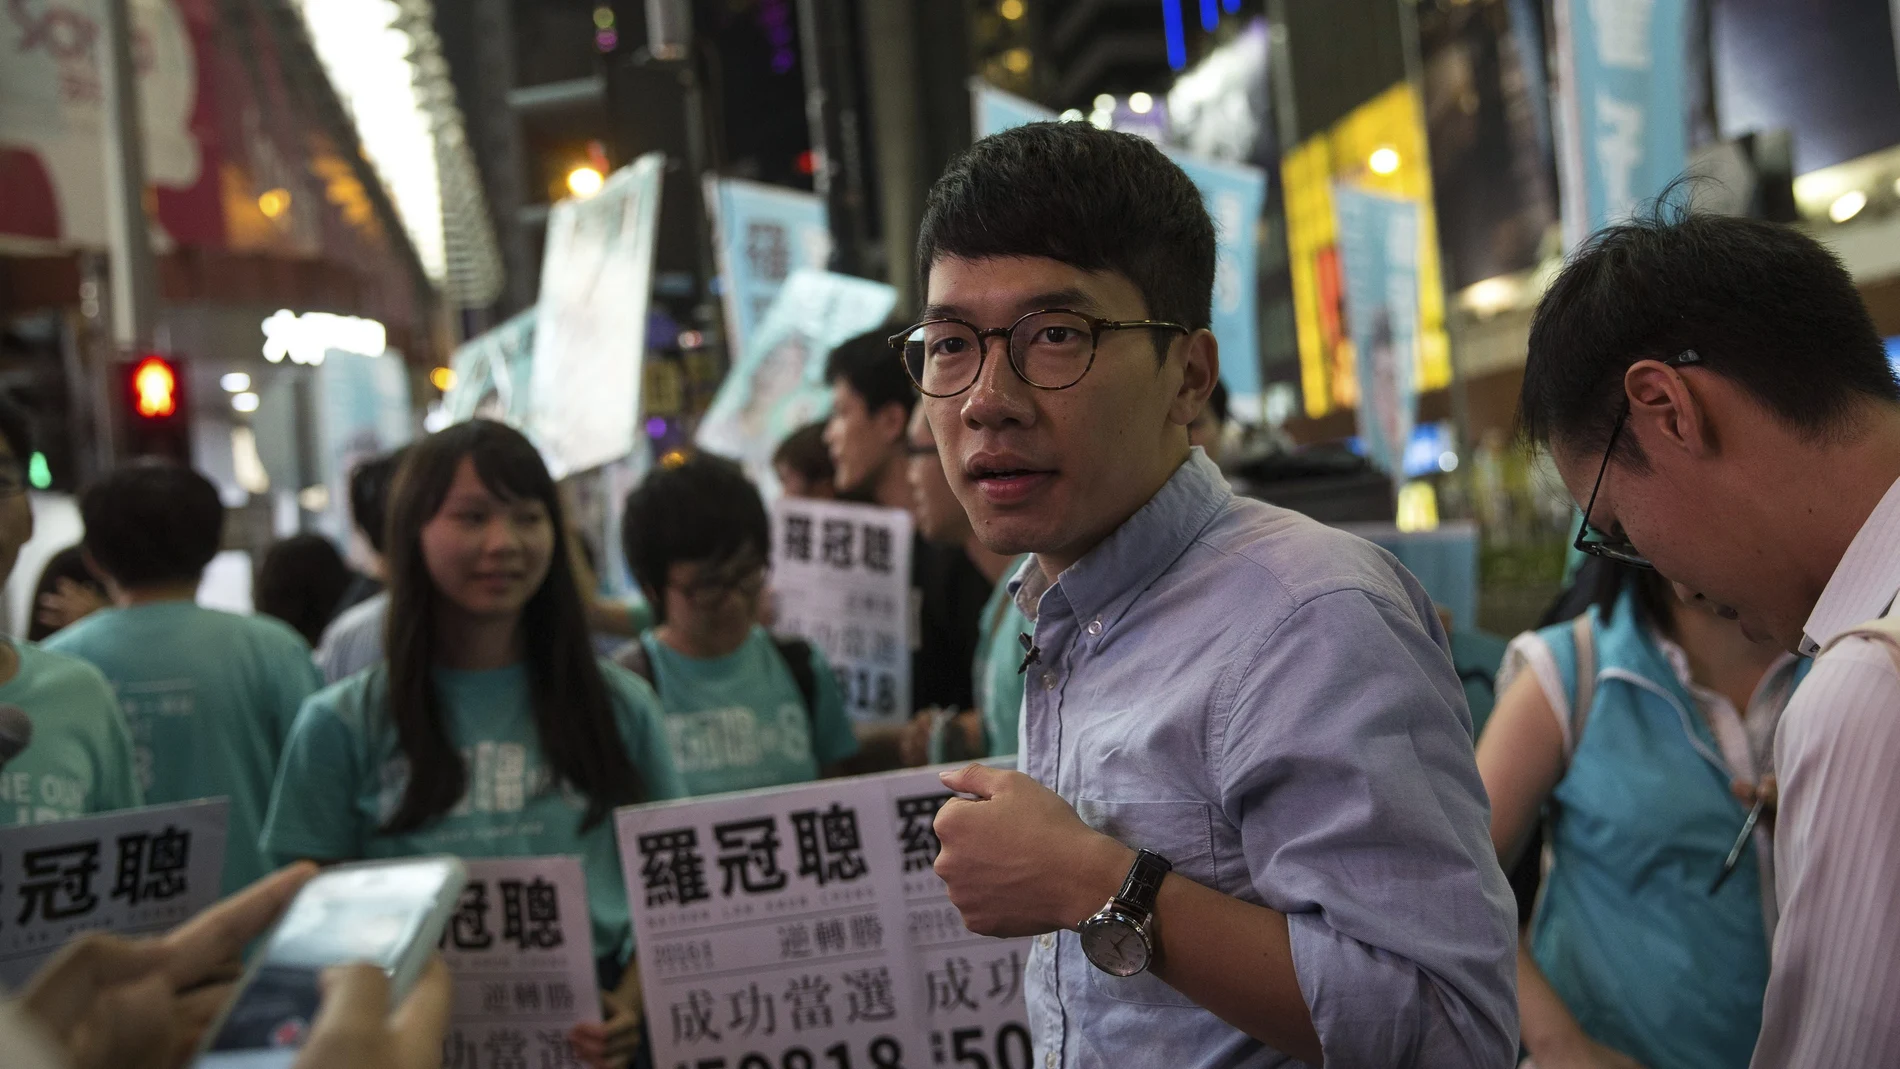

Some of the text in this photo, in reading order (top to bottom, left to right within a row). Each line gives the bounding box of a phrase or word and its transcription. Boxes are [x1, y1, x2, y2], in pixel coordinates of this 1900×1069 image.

[0, 825, 192, 927] 冠聰
[638, 803, 868, 908] 羅冠聰
[669, 965, 898, 1047] 成功當選
